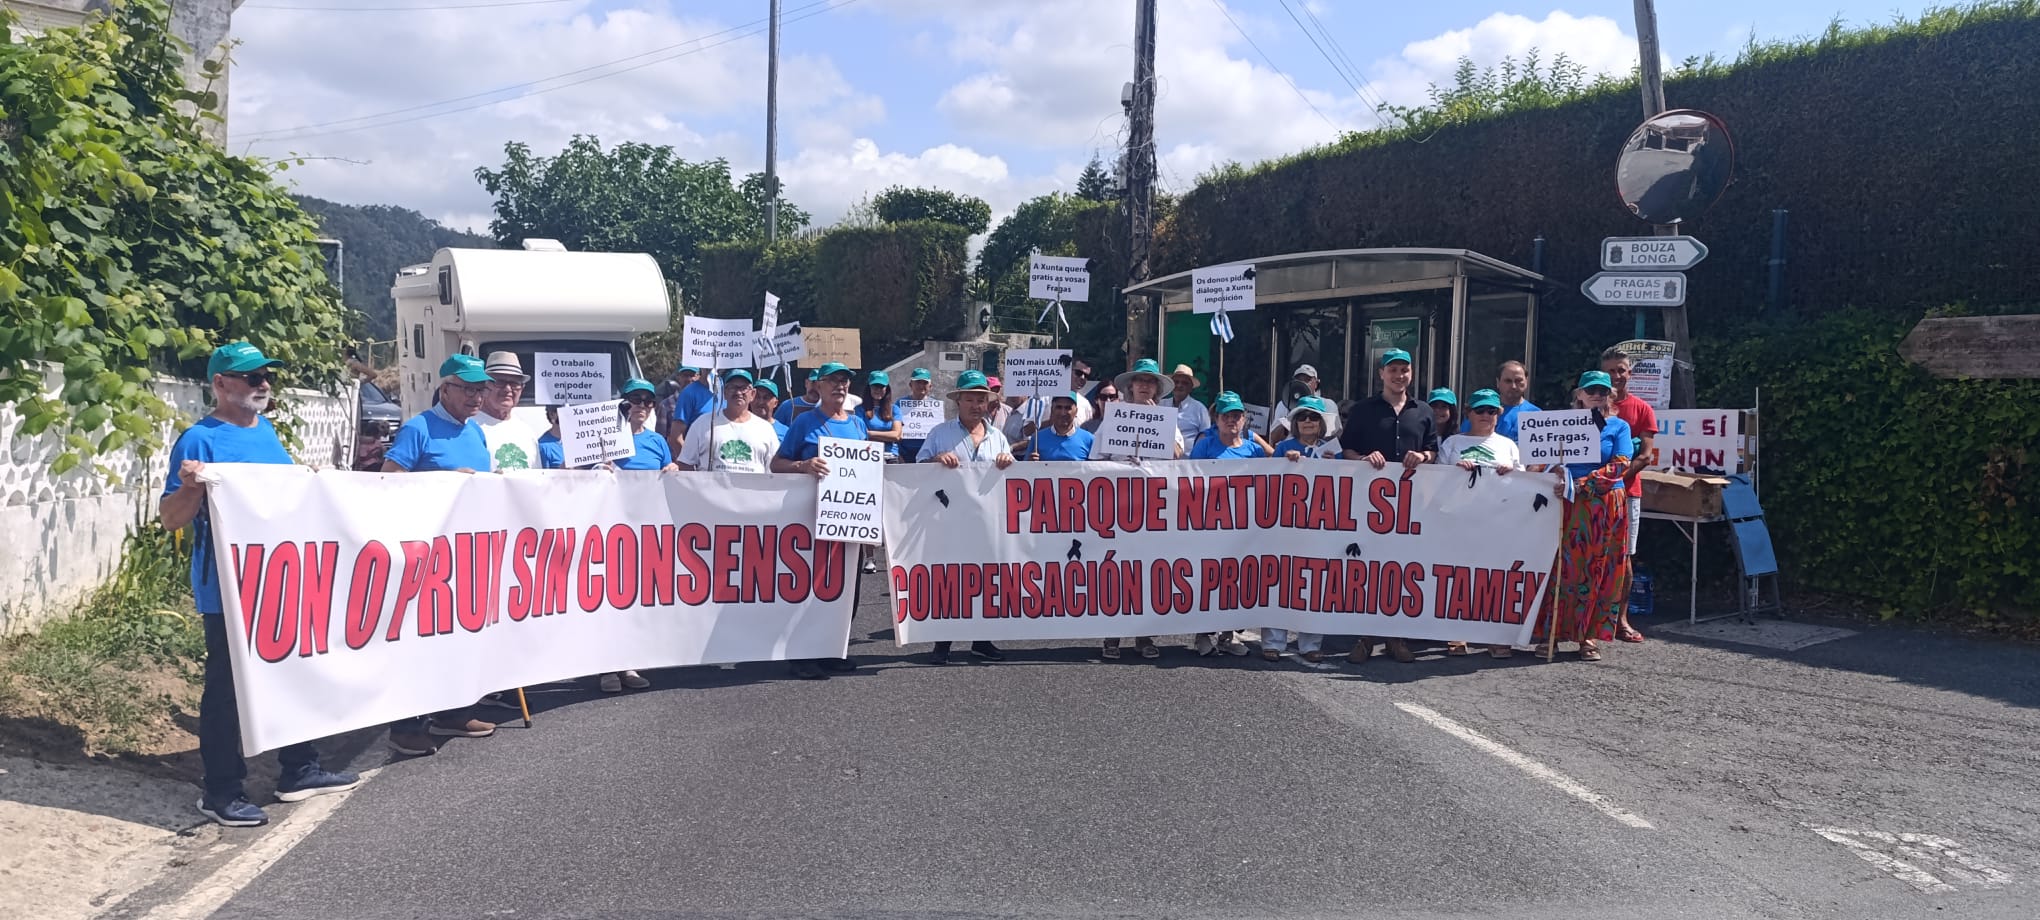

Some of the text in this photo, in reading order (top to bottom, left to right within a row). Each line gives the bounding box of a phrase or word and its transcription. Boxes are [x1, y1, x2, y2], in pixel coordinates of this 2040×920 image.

[1631, 243, 1676, 252] BOUZA
[1631, 254, 1676, 264] LONGA
[1040, 263, 1063, 272] Xunta
[1031, 273, 1053, 281] gratis
[1207, 276, 1229, 284] donos
[1046, 284, 1072, 293] Fragas
[1613, 279, 1661, 288] FRAGAS
[1204, 295, 1243, 303] imposición
[1604, 290, 1661, 299] DO EUME
[690, 327, 706, 336] Non
[707, 327, 745, 338] podemos
[728, 339, 743, 347] das
[691, 349, 743, 359] Nosas Fragas
[551, 359, 559, 367] O
[1026, 358, 1046, 366] mais
[580, 370, 605, 379] Abós,
[1028, 369, 1063, 377] FRAGAS,
[567, 381, 593, 391] poder
[573, 403, 617, 416] Xa van dous
[901, 400, 940, 408] RESPETO
[1114, 409, 1165, 423] As Fragas
[1521, 416, 1595, 430] ¿Quén coida
[1702, 414, 1728, 437] SÍ
[576, 425, 622, 440] 2012 y 2025
[1116, 425, 1160, 436] con nos,
[603, 439, 617, 447] hay
[1529, 432, 1590, 444] As Fragas,
[1108, 438, 1166, 450] non ardían
[823, 445, 881, 463] SOMOS
[1531, 446, 1589, 457] do lume ?
[1672, 447, 1725, 467] NON
[839, 467, 857, 478] DA
[821, 489, 877, 506] ALDEA
[1006, 469, 1422, 539] PARQUE NATURAL SÍ.
[820, 510, 871, 521] PERO NON
[817, 523, 880, 539] TONTOS
[345, 540, 391, 650] O
[507, 527, 576, 622] SIN
[892, 550, 1144, 623] COMPENSACIÓN
[1151, 558, 1194, 615] OS
[1200, 554, 1425, 618] PROPIETARIOS
